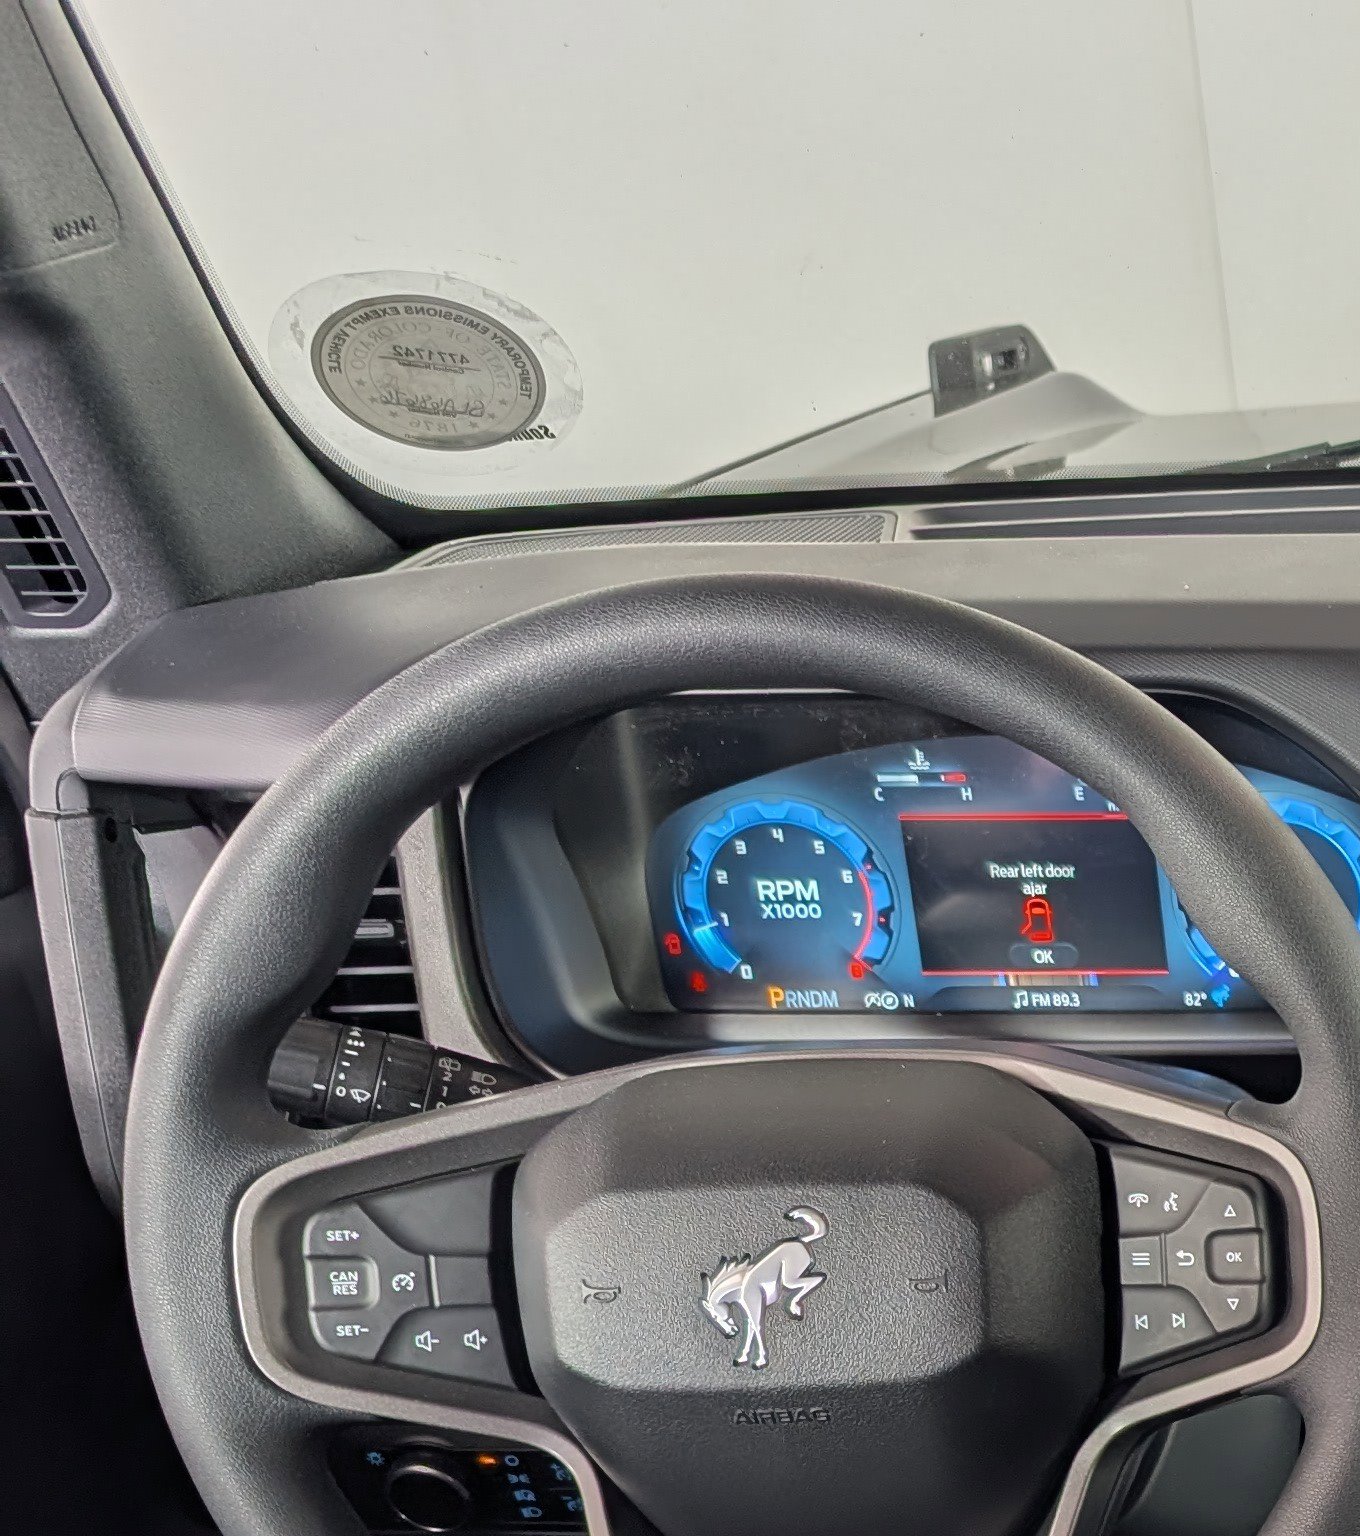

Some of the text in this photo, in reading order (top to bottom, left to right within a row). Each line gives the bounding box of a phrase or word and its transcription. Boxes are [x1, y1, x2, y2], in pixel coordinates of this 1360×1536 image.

[874, 787, 973, 801] C H
[1074, 786, 1085, 801] E
[772, 828, 784, 844] 4
[735, 840, 747, 855] 3
[814, 839, 825, 855] 5
[716, 870, 729, 885] 2
[842, 870, 853, 884] 6
[989, 862, 1075, 879] Rear left door
[757, 879, 820, 902] RPM
[1022, 882, 1048, 897] ajar
[761, 903, 822, 920] X1000
[720, 913, 730, 927] 1
[852, 912, 863, 927] 7
[1033, 950, 1055, 965] OK
[740, 965, 753, 980] 0
[769, 987, 839, 1009] PRNDM
[903, 994, 914, 1008] N
[1031, 992, 1080, 1007] FM 89.3
[1183, 993, 1208, 1007] 82°
[326, 1230, 360, 1242] SET+
[1225, 1251, 1243, 1263] OK
[329, 1271, 359, 1283] CAN
[332, 1284, 358, 1296] RES
[733, 1406, 832, 1425] AIRBAG
